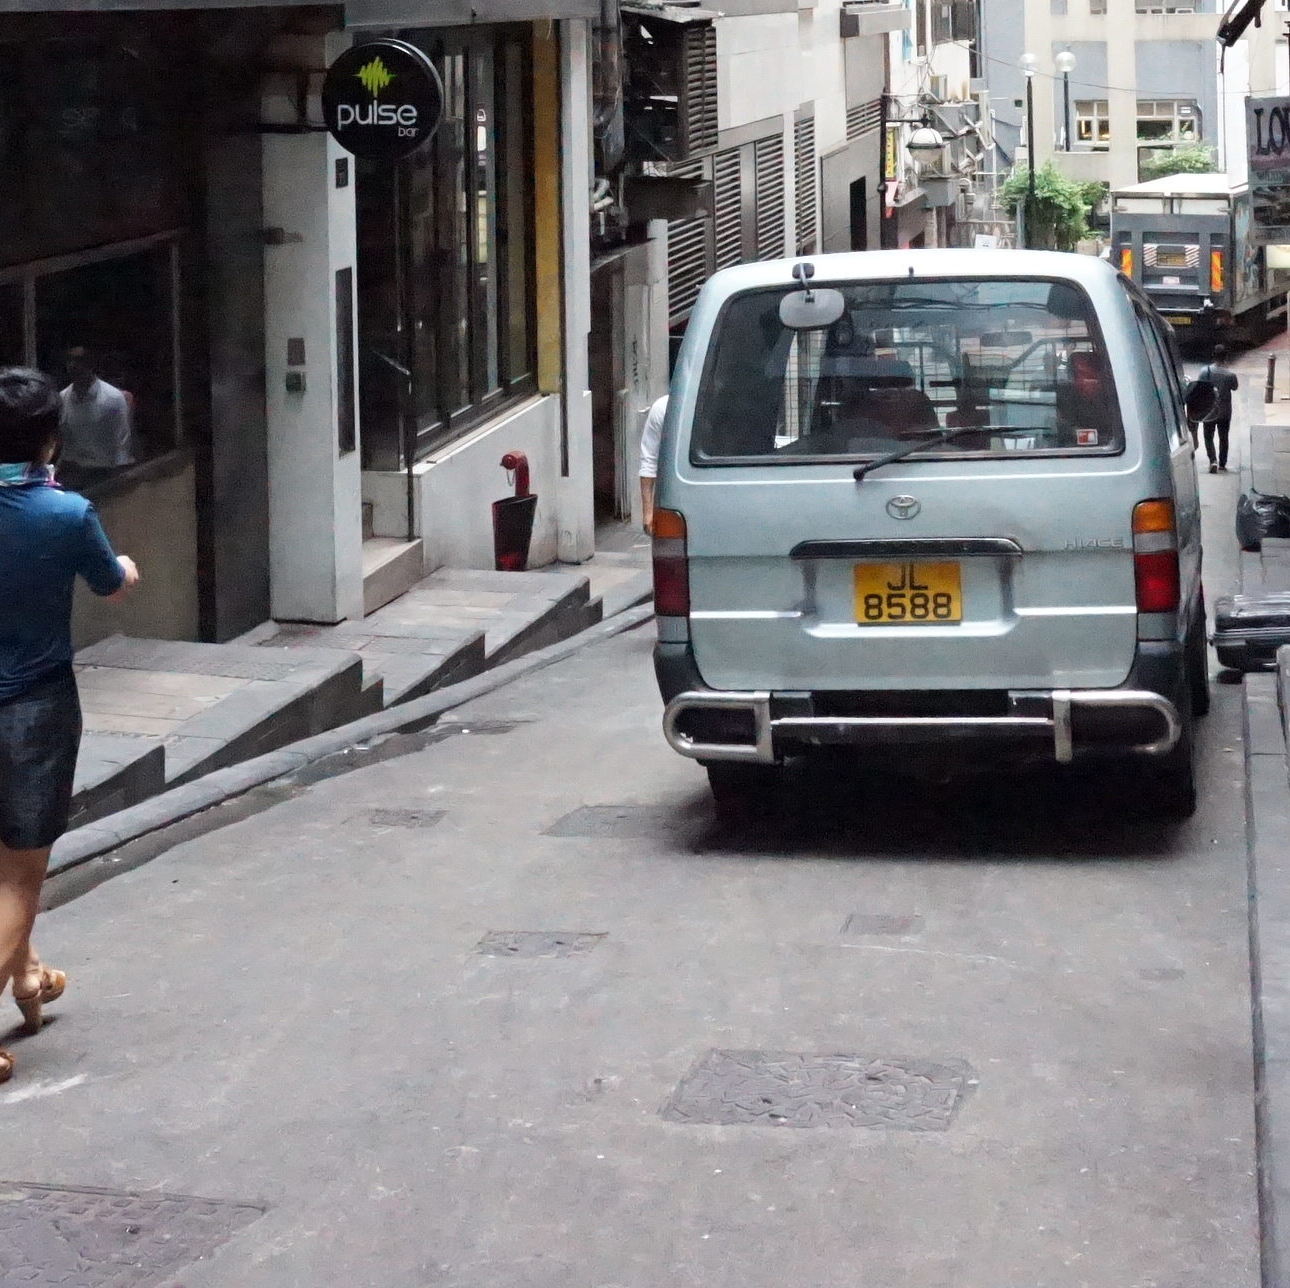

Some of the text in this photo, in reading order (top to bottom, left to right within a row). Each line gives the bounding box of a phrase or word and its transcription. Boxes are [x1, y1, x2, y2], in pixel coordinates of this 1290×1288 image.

[338, 99, 417, 131] pulse
[398, 127, 419, 137] bar
[1065, 537, 1123, 549] HIACE
[887, 561, 929, 591] JL
[864, 593, 952, 620] 8588
